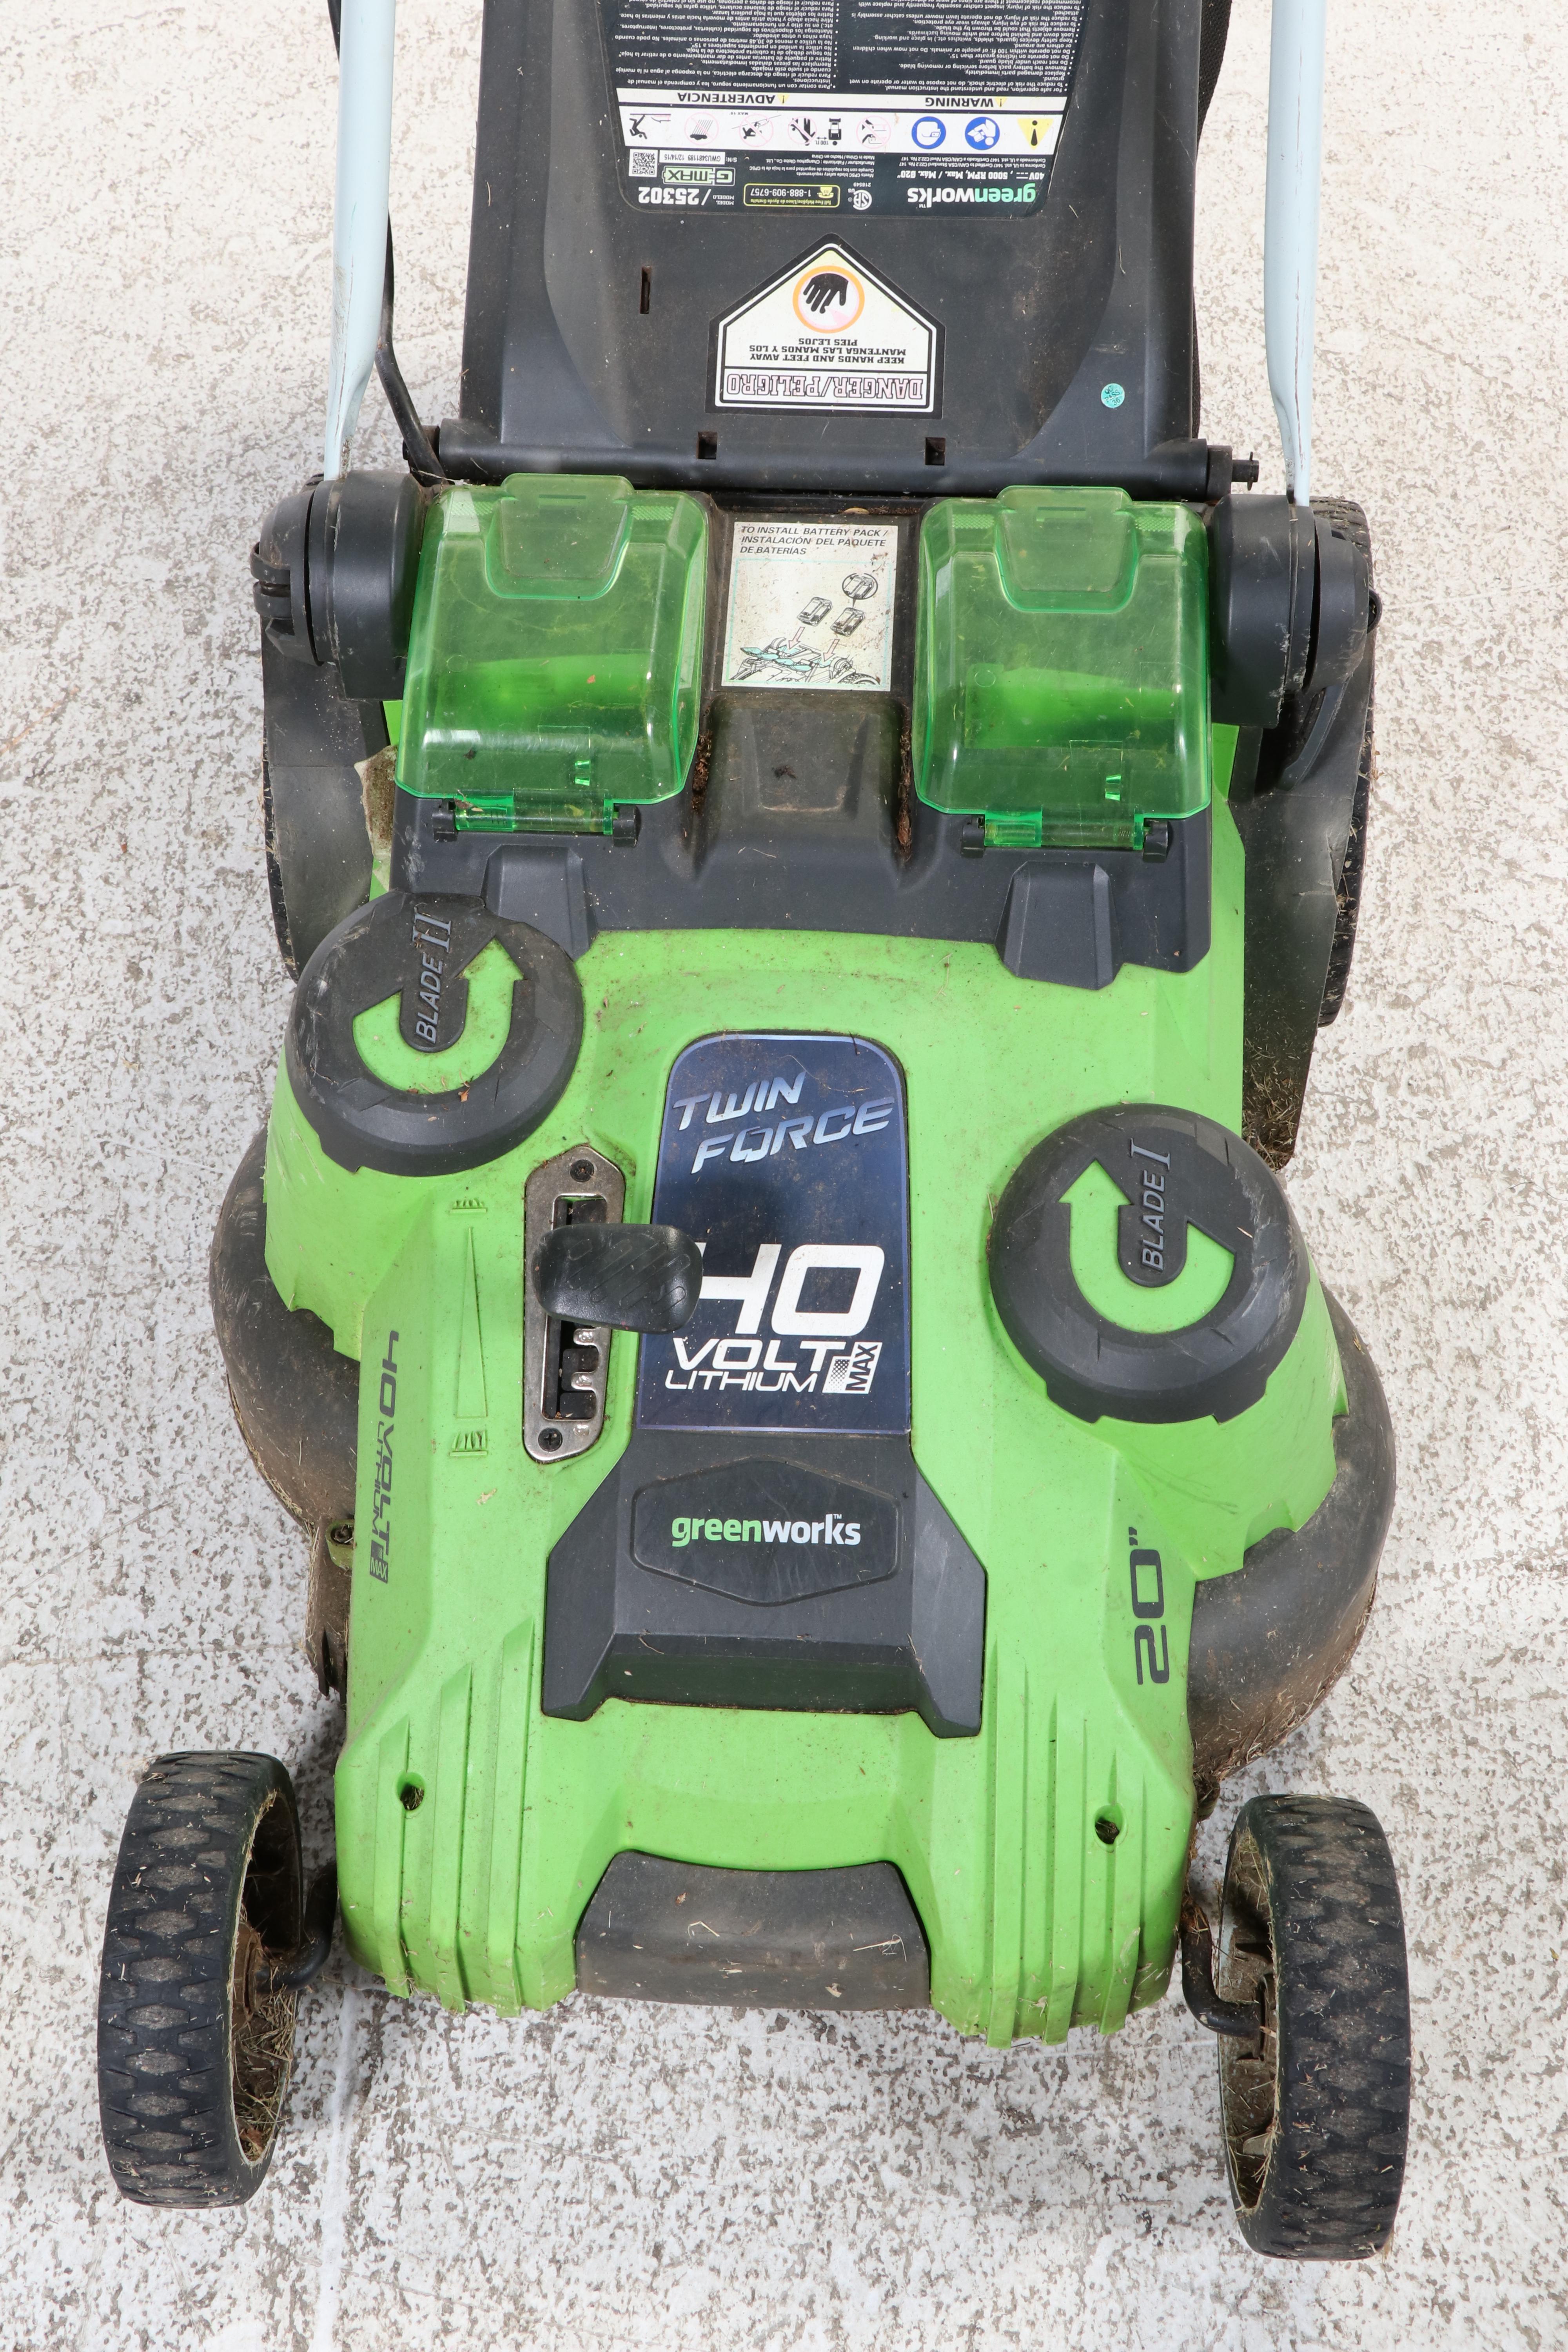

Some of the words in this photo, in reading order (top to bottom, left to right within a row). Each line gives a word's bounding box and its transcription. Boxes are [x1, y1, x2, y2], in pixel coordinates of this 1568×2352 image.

[677, 93, 775, 104] ADVERTENCIA
[926, 97, 993, 107] WARNING
[918, 171, 936, 179] Máx.
[945, 171, 963, 179] Max.
[965, 170, 986, 180] RPM,
[750, 188, 811, 197] 1-888-909-6757
[907, 182, 1036, 208] greenworks
[726, 373, 923, 399] DANGER/PELIGRO
[741, 535, 811, 545] INSTALACIÓN
[816, 537, 835, 546] DEL
[837, 538, 886, 547] PAQUETE
[757, 526, 799, 535] INSTALL
[803, 527, 849, 536] BATTERY
[756, 546, 807, 555] BATERÍAS
[416, 952, 444, 1044] BLADE
[672, 1070, 806, 1131] TWIN
[691, 1097, 895, 1174] FORCE
[1141, 1170, 1166, 1271] BLADE
[673, 1337, 846, 1371] VOLT
[379, 1330, 399, 1418] 40
[845, 1343, 878, 1392] MAX
[665, 1369, 817, 1393] LITHIUM
[372, 1421, 385, 1534] LITHIUM
[379, 1424, 394, 1555] VOLT
[671, 1513, 861, 1548] greenworks
[370, 1559, 388, 1581] MAX
